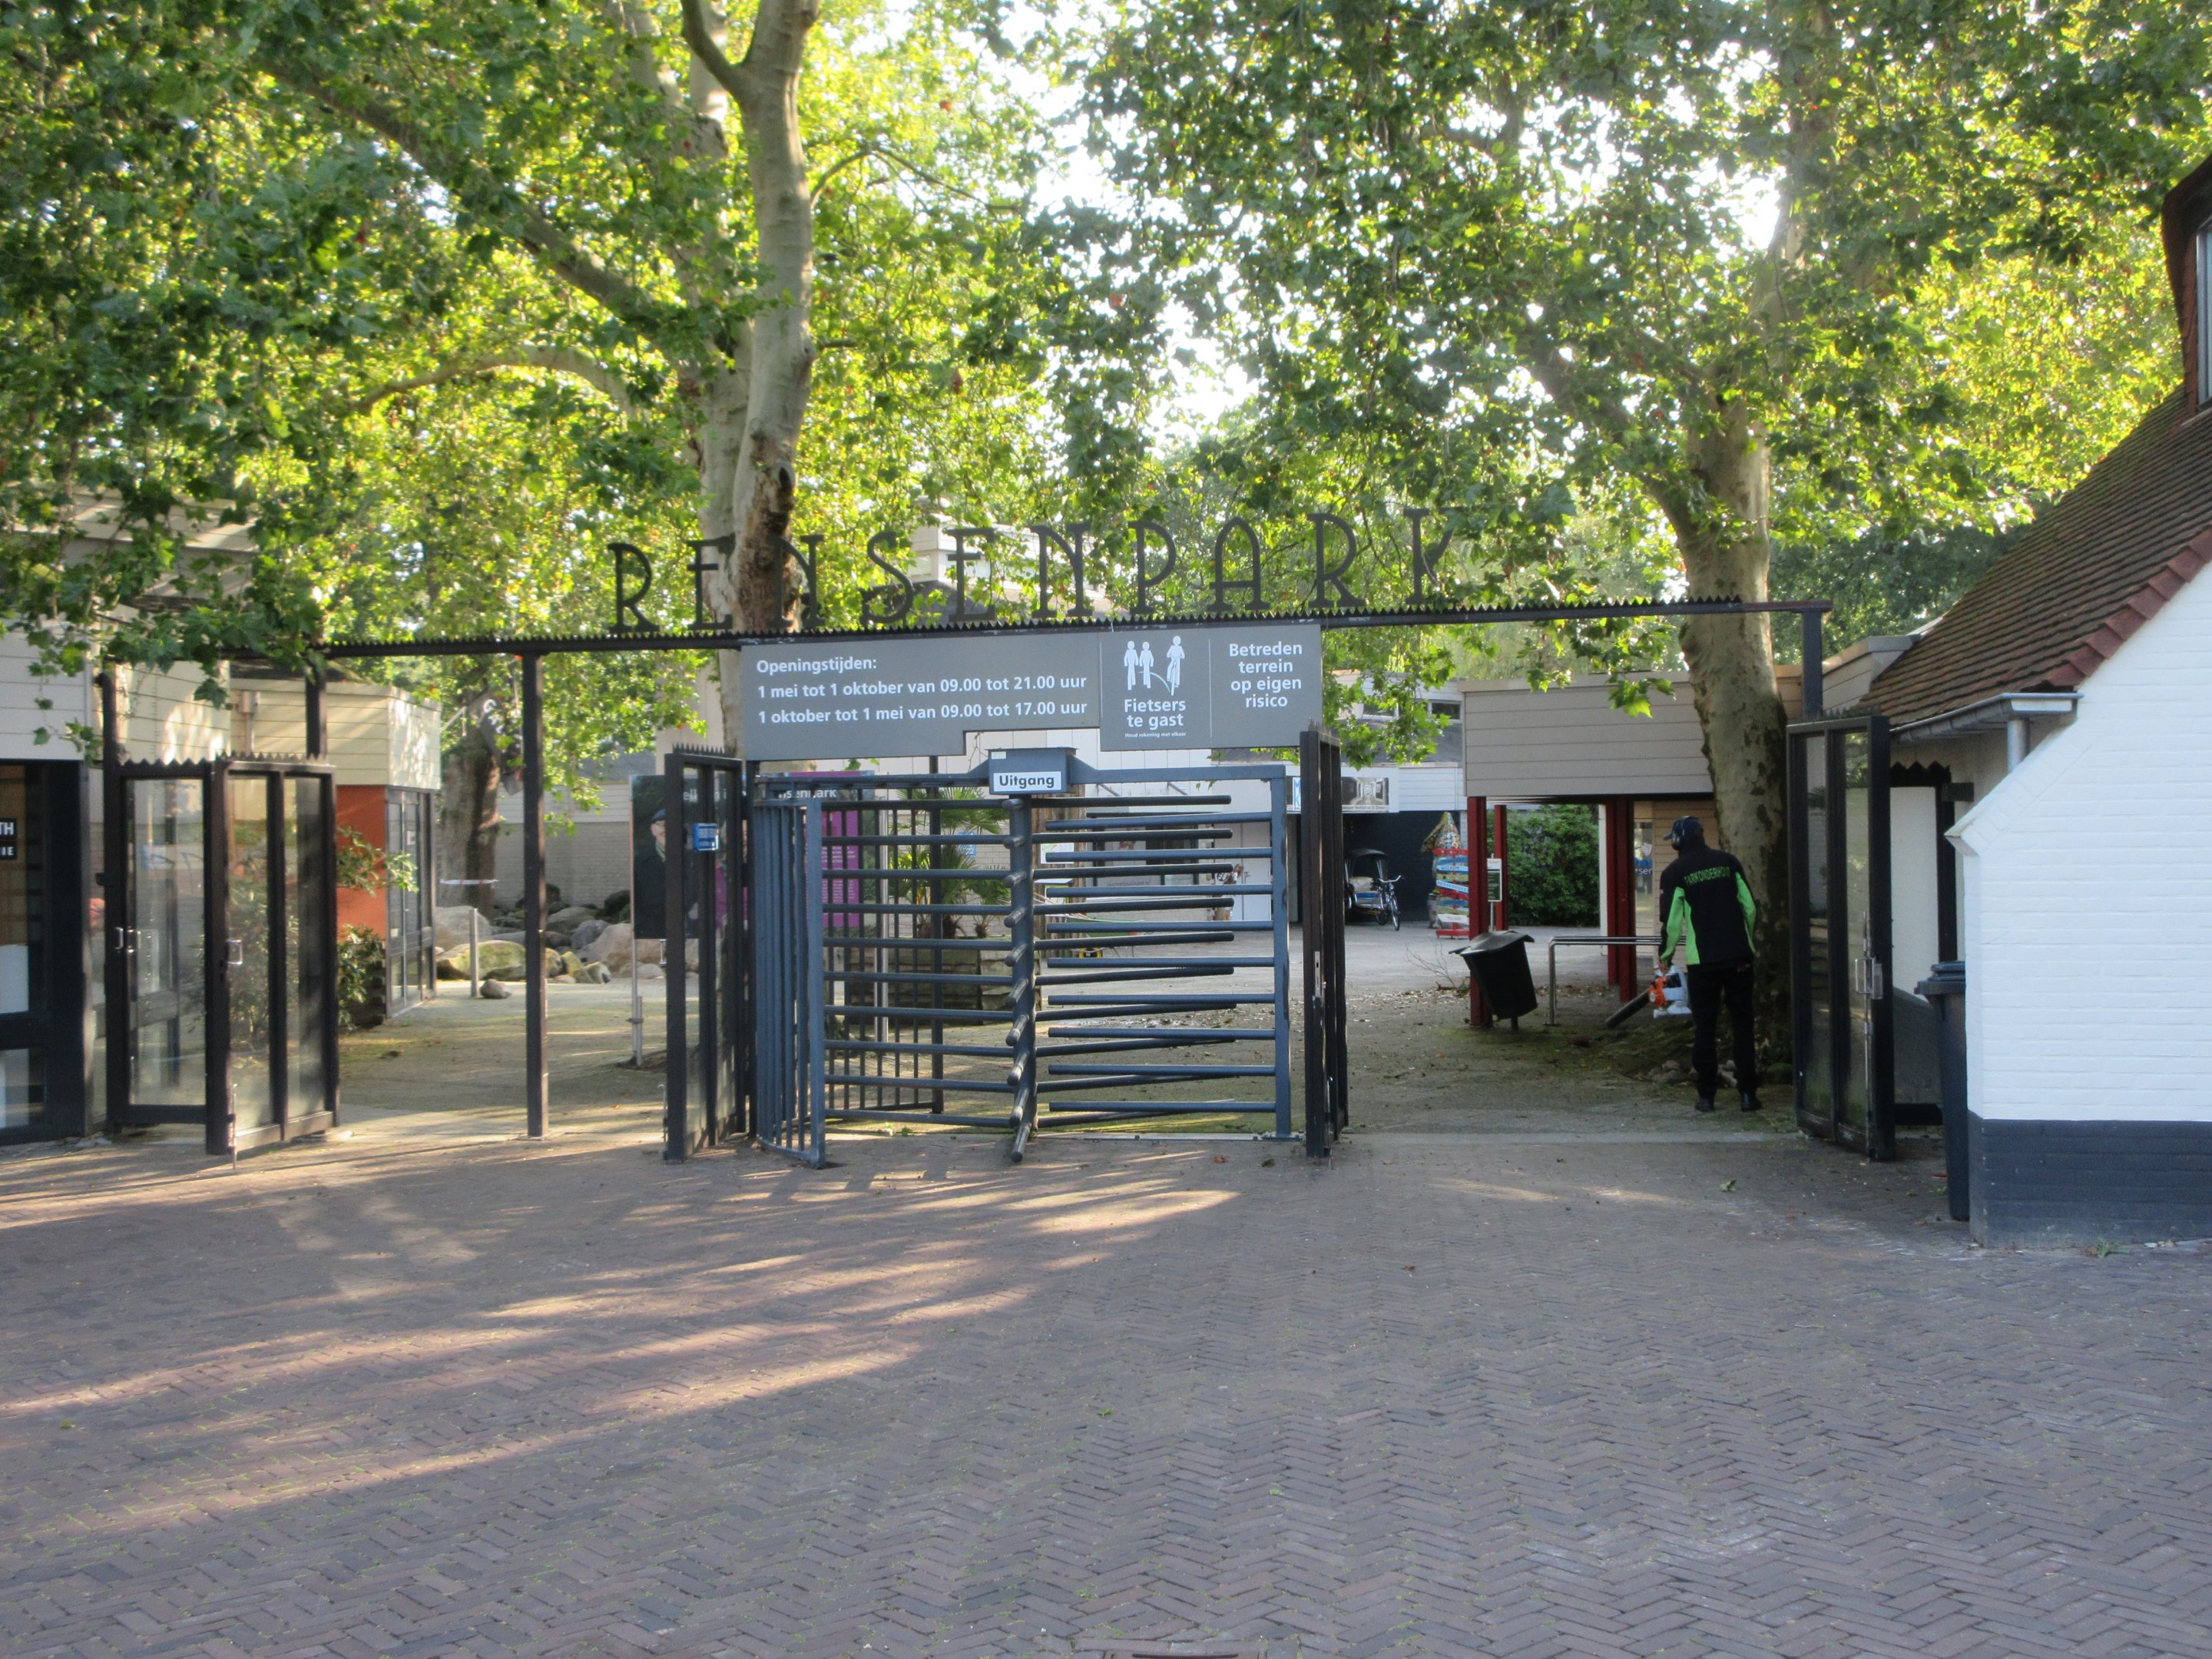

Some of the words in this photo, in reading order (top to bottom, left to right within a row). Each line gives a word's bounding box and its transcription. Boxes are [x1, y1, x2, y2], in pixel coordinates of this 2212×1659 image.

[608, 506, 1465, 633] RENSENPARK
[1229, 641, 1303, 657] Betreden
[757, 656, 877, 675] Openingstijden:
[1238, 658, 1293, 674] terrein
[757, 685, 765, 698] 1
[770, 684, 798, 697] mei
[802, 684, 826, 697] tot
[830, 684, 837, 696] 1
[843, 680, 903, 695] oktober
[907, 682, 935, 694] van
[940, 678, 982, 692] 09.00
[985, 677, 1009, 690] tot
[1014, 676, 1055, 690] 21.00
[1060, 677, 1087, 689] uur
[1230, 680, 1252, 694] op
[1257, 676, 1302, 694] eigen
[1124, 698, 1186, 713] Fietsers
[1246, 694, 1288, 708] risico
[758, 711, 766, 724] 1
[771, 709, 831, 724] oktober
[835, 709, 858, 721] tot
[863, 707, 870, 720] 1
[876, 706, 903, 720] mei
[908, 707, 935, 719] van
[941, 704, 982, 718] 09.00
[986, 704, 1009, 717] tot
[1015, 701, 1055, 716] 17.00
[1060, 702, 1087, 714] uur
[1127, 715, 1144, 727] te
[1148, 714, 1184, 730] gast
[999, 775, 1055, 790] Uitgang
